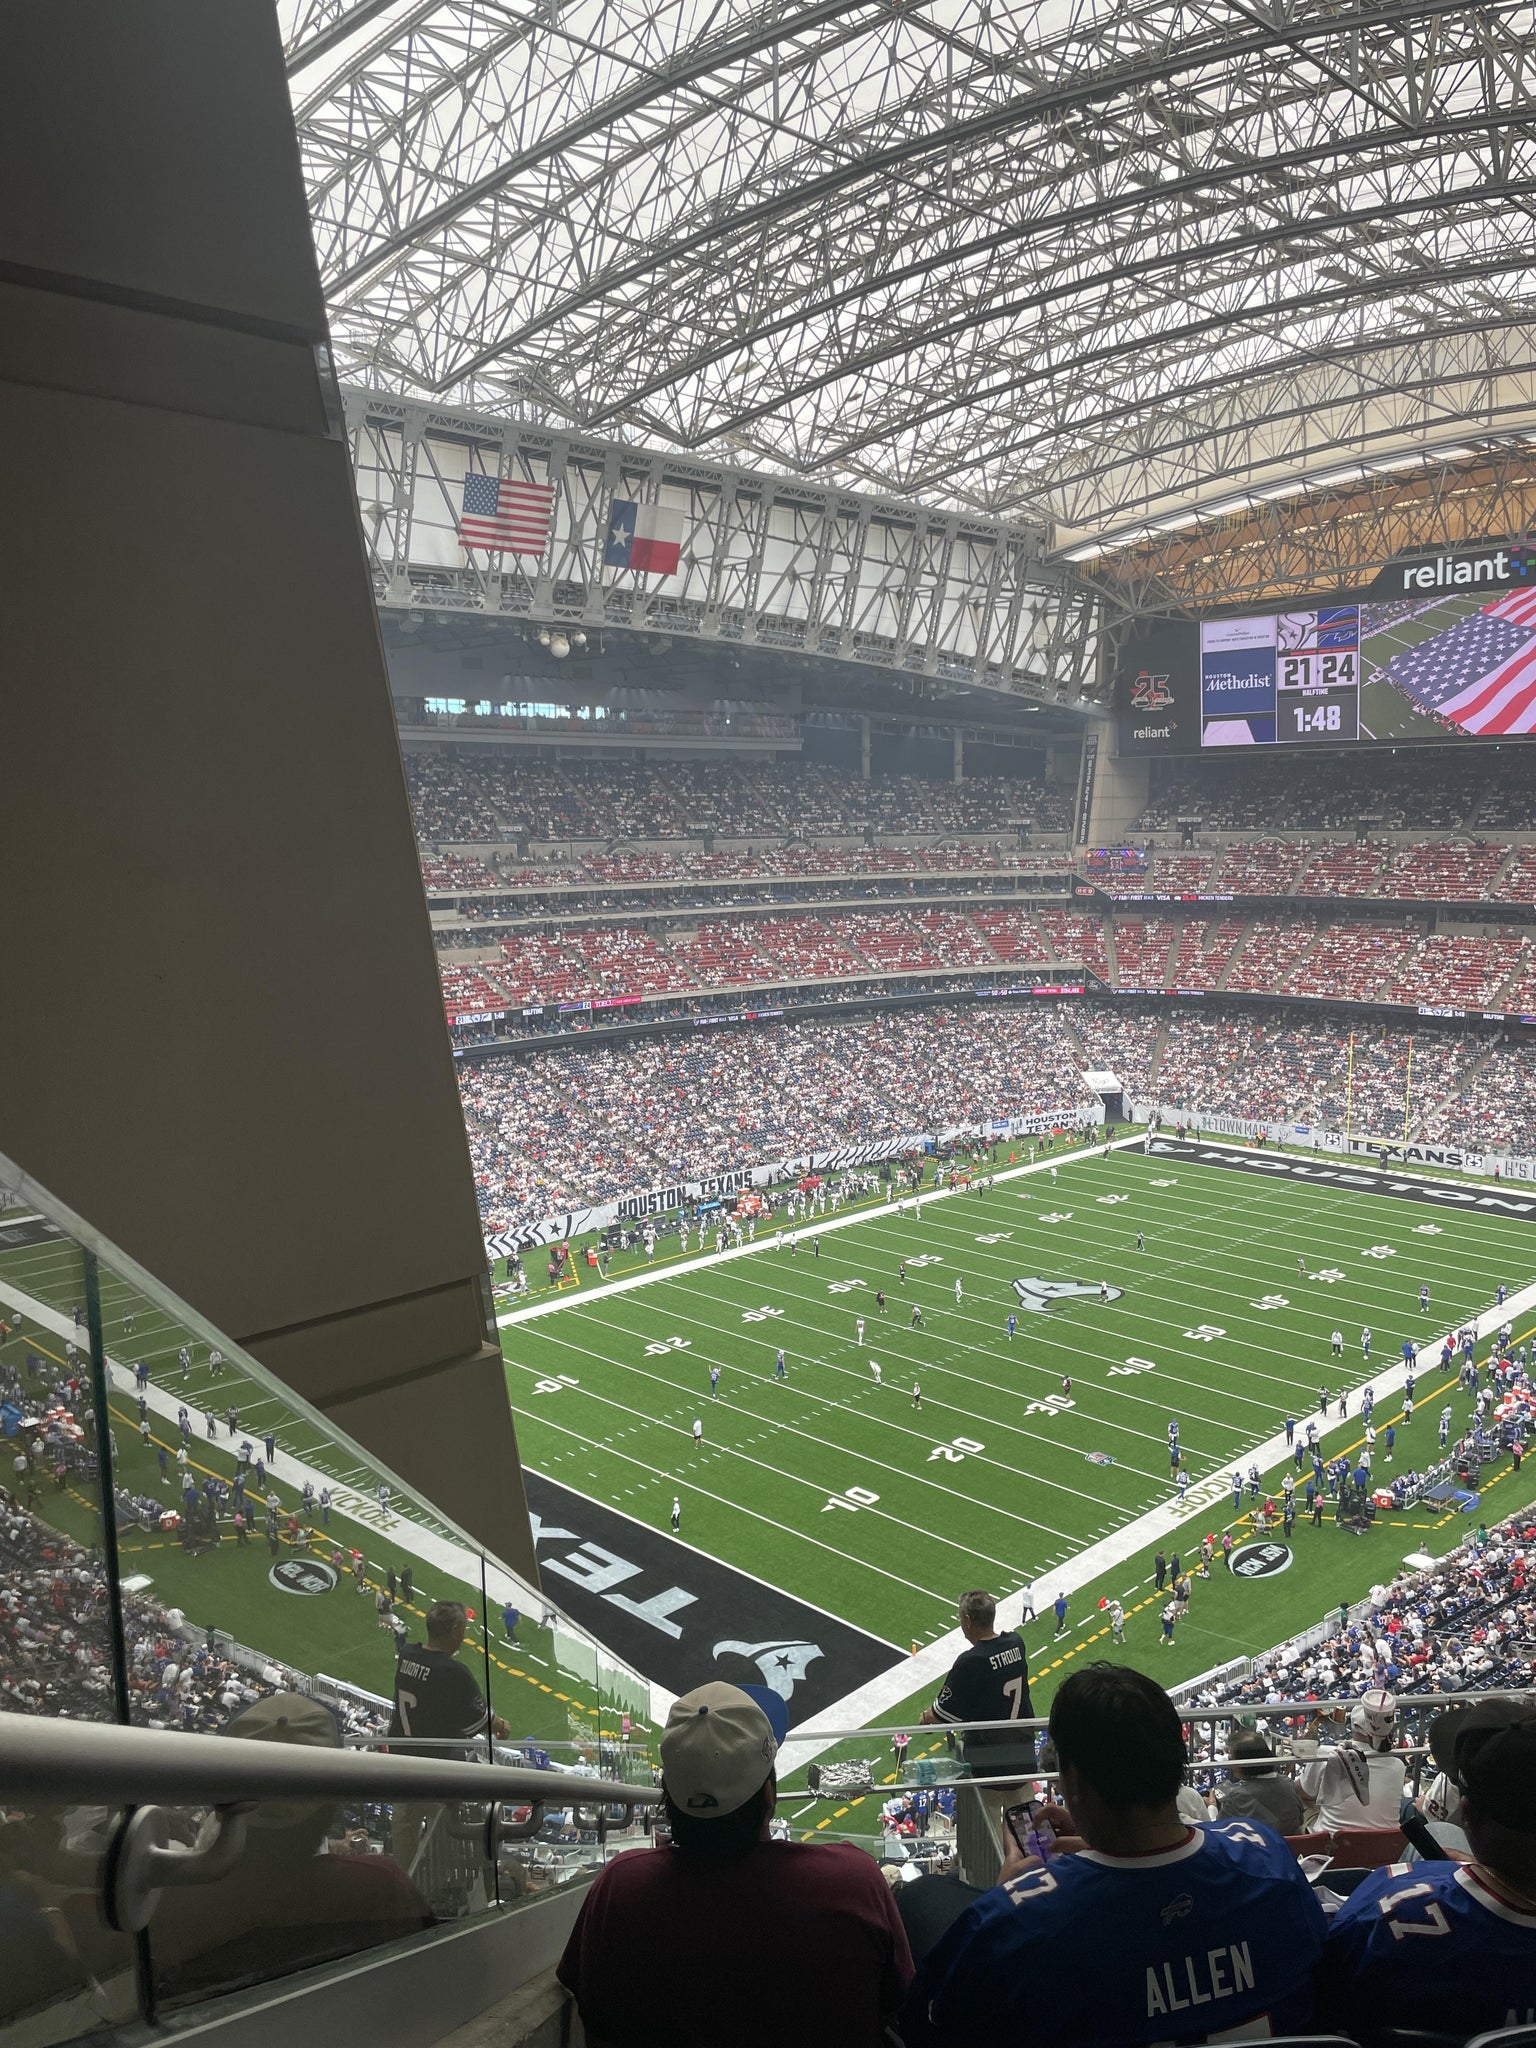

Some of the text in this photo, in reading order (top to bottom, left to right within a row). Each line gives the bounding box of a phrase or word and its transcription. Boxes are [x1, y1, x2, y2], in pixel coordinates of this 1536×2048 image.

[1403, 552, 1510, 590] reliant
[1284, 658, 1310, 686] 21
[1322, 654, 1355, 683] 24
[1134, 674, 1170, 706] 25
[1205, 674, 1271, 691] Methodist
[1302, 688, 1328, 696] HALFTIME
[1293, 705, 1341, 732] 1:48
[1134, 726, 1170, 738] reliant
[1026, 1112, 1077, 1125] HOUSTON
[1026, 1121, 1076, 1134] TEXAN
[1326, 1134, 1340, 1145] 25
[1350, 1140, 1463, 1166] TEXANS
[1467, 1155, 1482, 1166] 25
[618, 1170, 753, 1217] HOUSTON TEXANS
[1198, 1152, 1536, 1212] HOUSTON
[645, 1337, 692, 1355] 20
[1183, 1325, 1227, 1342] 50
[1110, 1357, 1156, 1376] 40
[535, 1375, 580, 1393] 10
[1026, 1394, 1076, 1417] 30
[931, 1437, 986, 1463] 20
[828, 1486, 881, 1512] 10
[1166, 1472, 1233, 1518] KICKOFF
[990, 1647, 1022, 1670] STROUD
[1003, 1675, 1023, 1720] 7
[919, 1798, 927, 1808] 17
[1002, 1867, 1058, 1906] 17
[1378, 1882, 1451, 1941] 17
[1145, 1940, 1255, 2018] ALLEN
